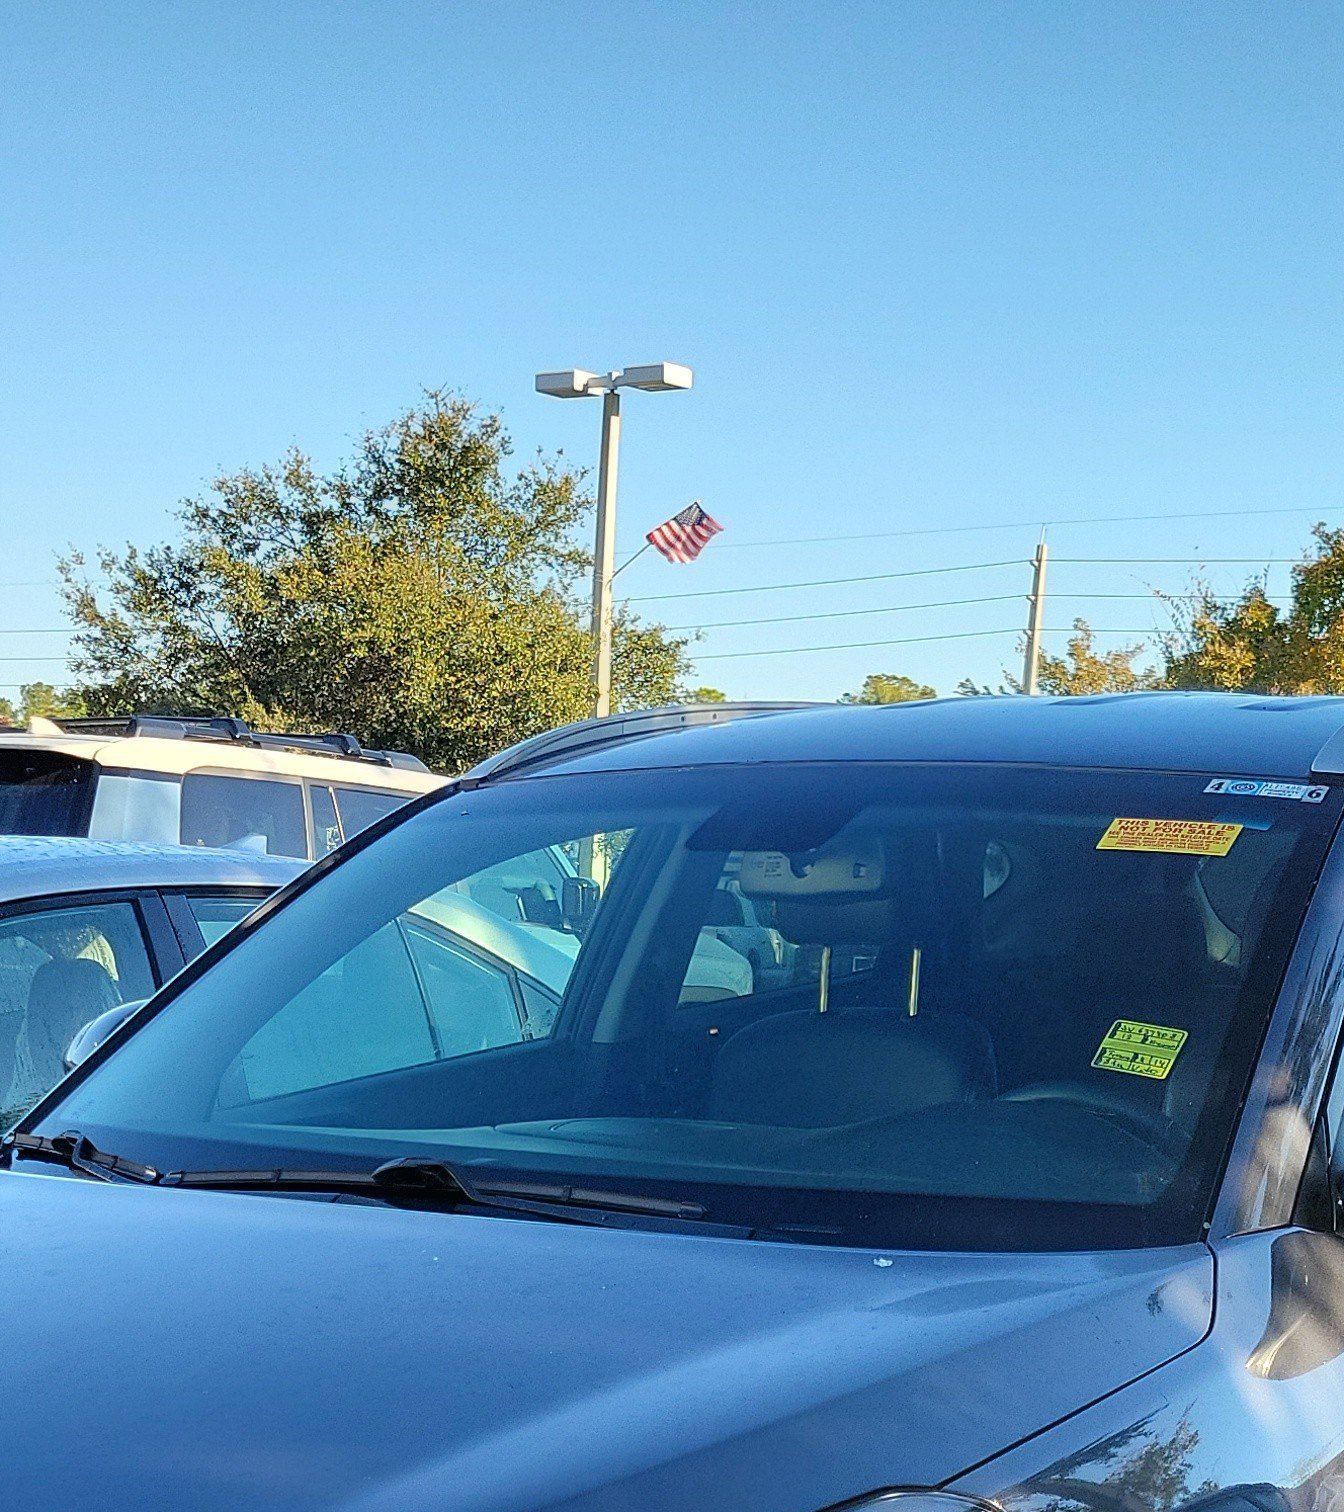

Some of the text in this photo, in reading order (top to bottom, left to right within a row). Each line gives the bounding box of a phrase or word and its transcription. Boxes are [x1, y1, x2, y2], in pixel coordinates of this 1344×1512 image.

[1117, 819, 1150, 827] THIS
[1155, 821, 1218, 830] VEHICLE
[1187, 829, 1226, 837] SALE
